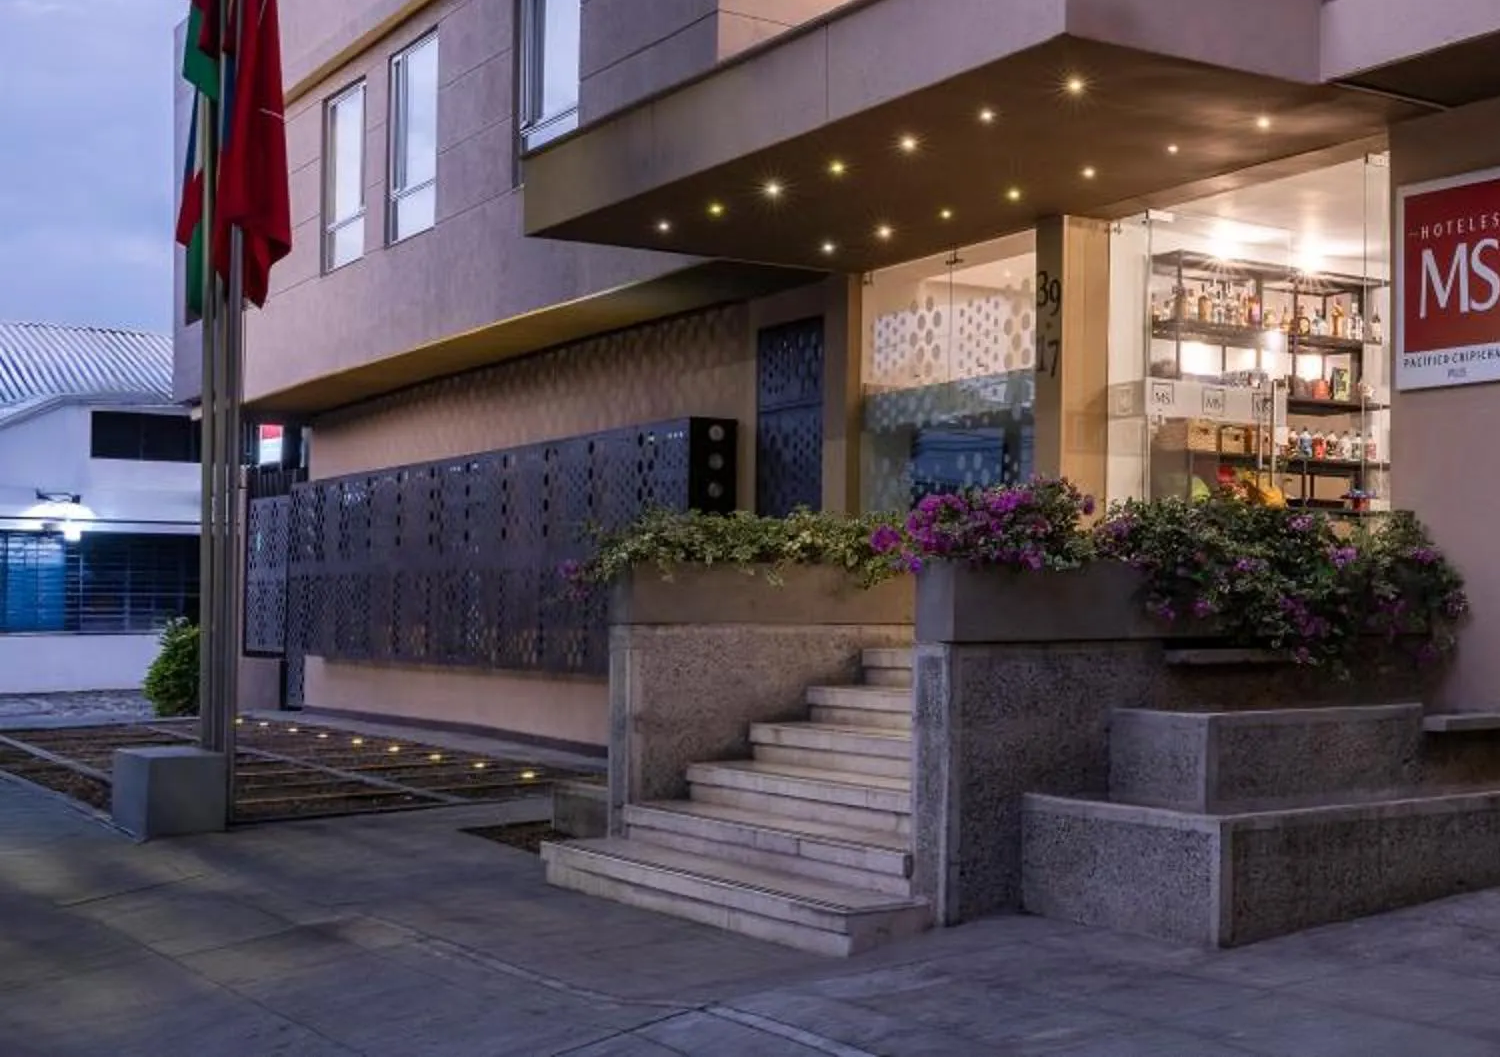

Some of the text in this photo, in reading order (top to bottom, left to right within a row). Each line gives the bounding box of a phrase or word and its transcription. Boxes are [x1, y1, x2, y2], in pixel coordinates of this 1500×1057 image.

[1421, 212, 1500, 240] HOTELES
[1036, 270, 1061, 317] 39
[1420, 238, 1500, 319] MS
[1036, 335, 1060, 378] 17
